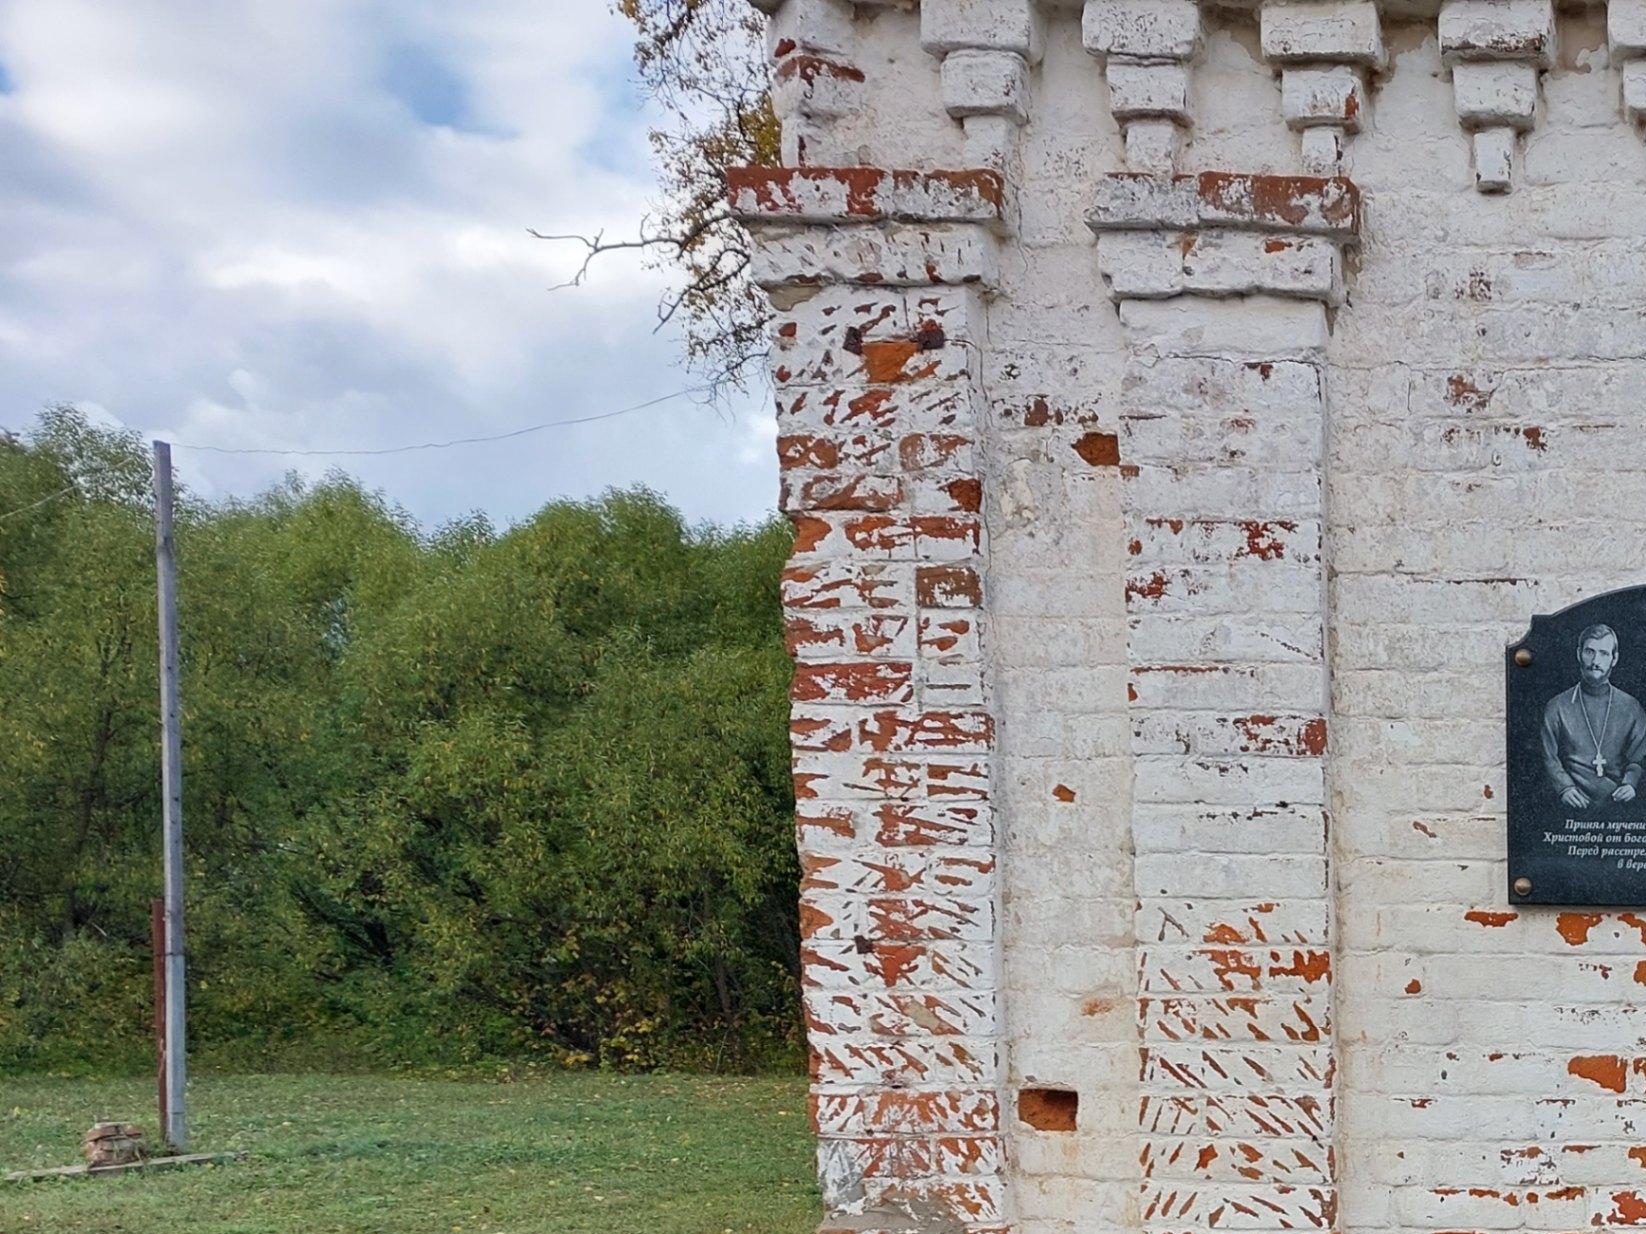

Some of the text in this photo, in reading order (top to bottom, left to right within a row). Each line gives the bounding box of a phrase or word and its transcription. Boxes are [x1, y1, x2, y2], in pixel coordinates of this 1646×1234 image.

[1565, 819, 1605, 832] Принял
[1542, 832, 1603, 845] Христовой
[1605, 835, 1622, 843] от
[1568, 846, 1599, 858] Перед
